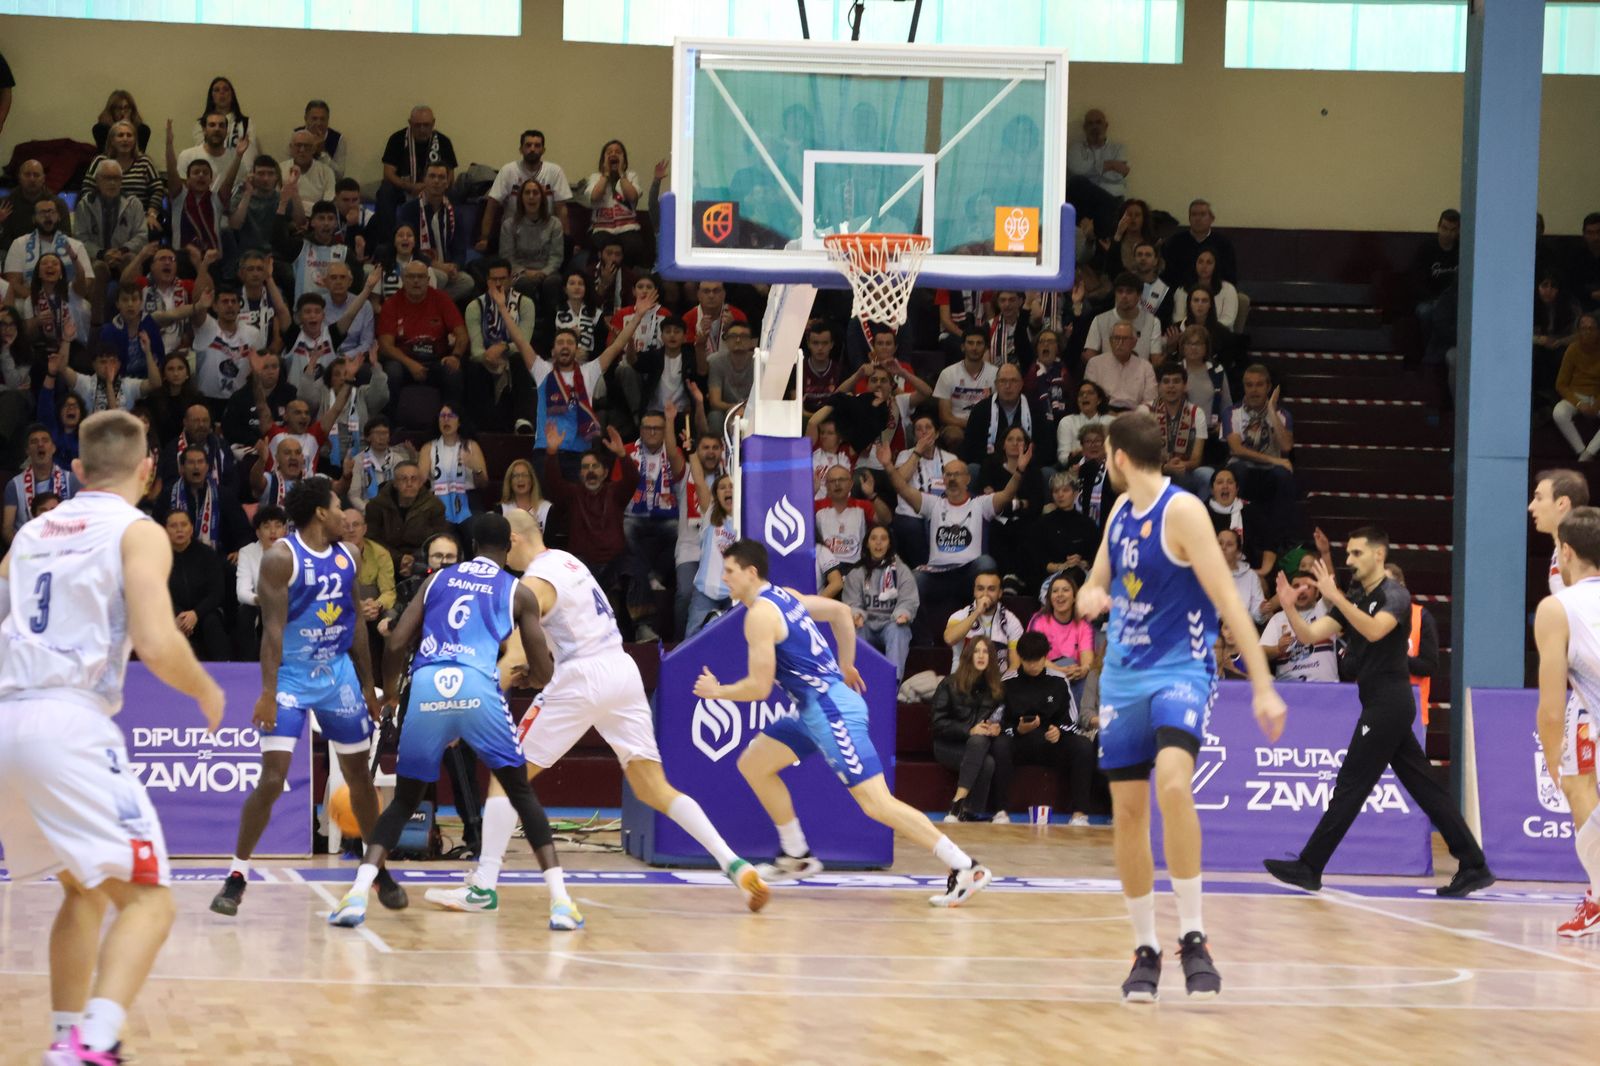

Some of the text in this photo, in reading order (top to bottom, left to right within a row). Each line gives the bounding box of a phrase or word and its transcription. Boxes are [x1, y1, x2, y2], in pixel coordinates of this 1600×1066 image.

[1120, 536, 1140, 569] 16
[457, 561, 499, 577] gaza
[315, 573, 344, 602] 22
[447, 577, 495, 595] SAINTEL
[29, 571, 53, 634] 3
[447, 594, 475, 630] 6
[419, 698, 481, 713] MORALEJO
[132, 727, 261, 748] DIPUTACIO
[1245, 780, 1411, 814] ZAMRA
[1522, 815, 1577, 838] Cas
